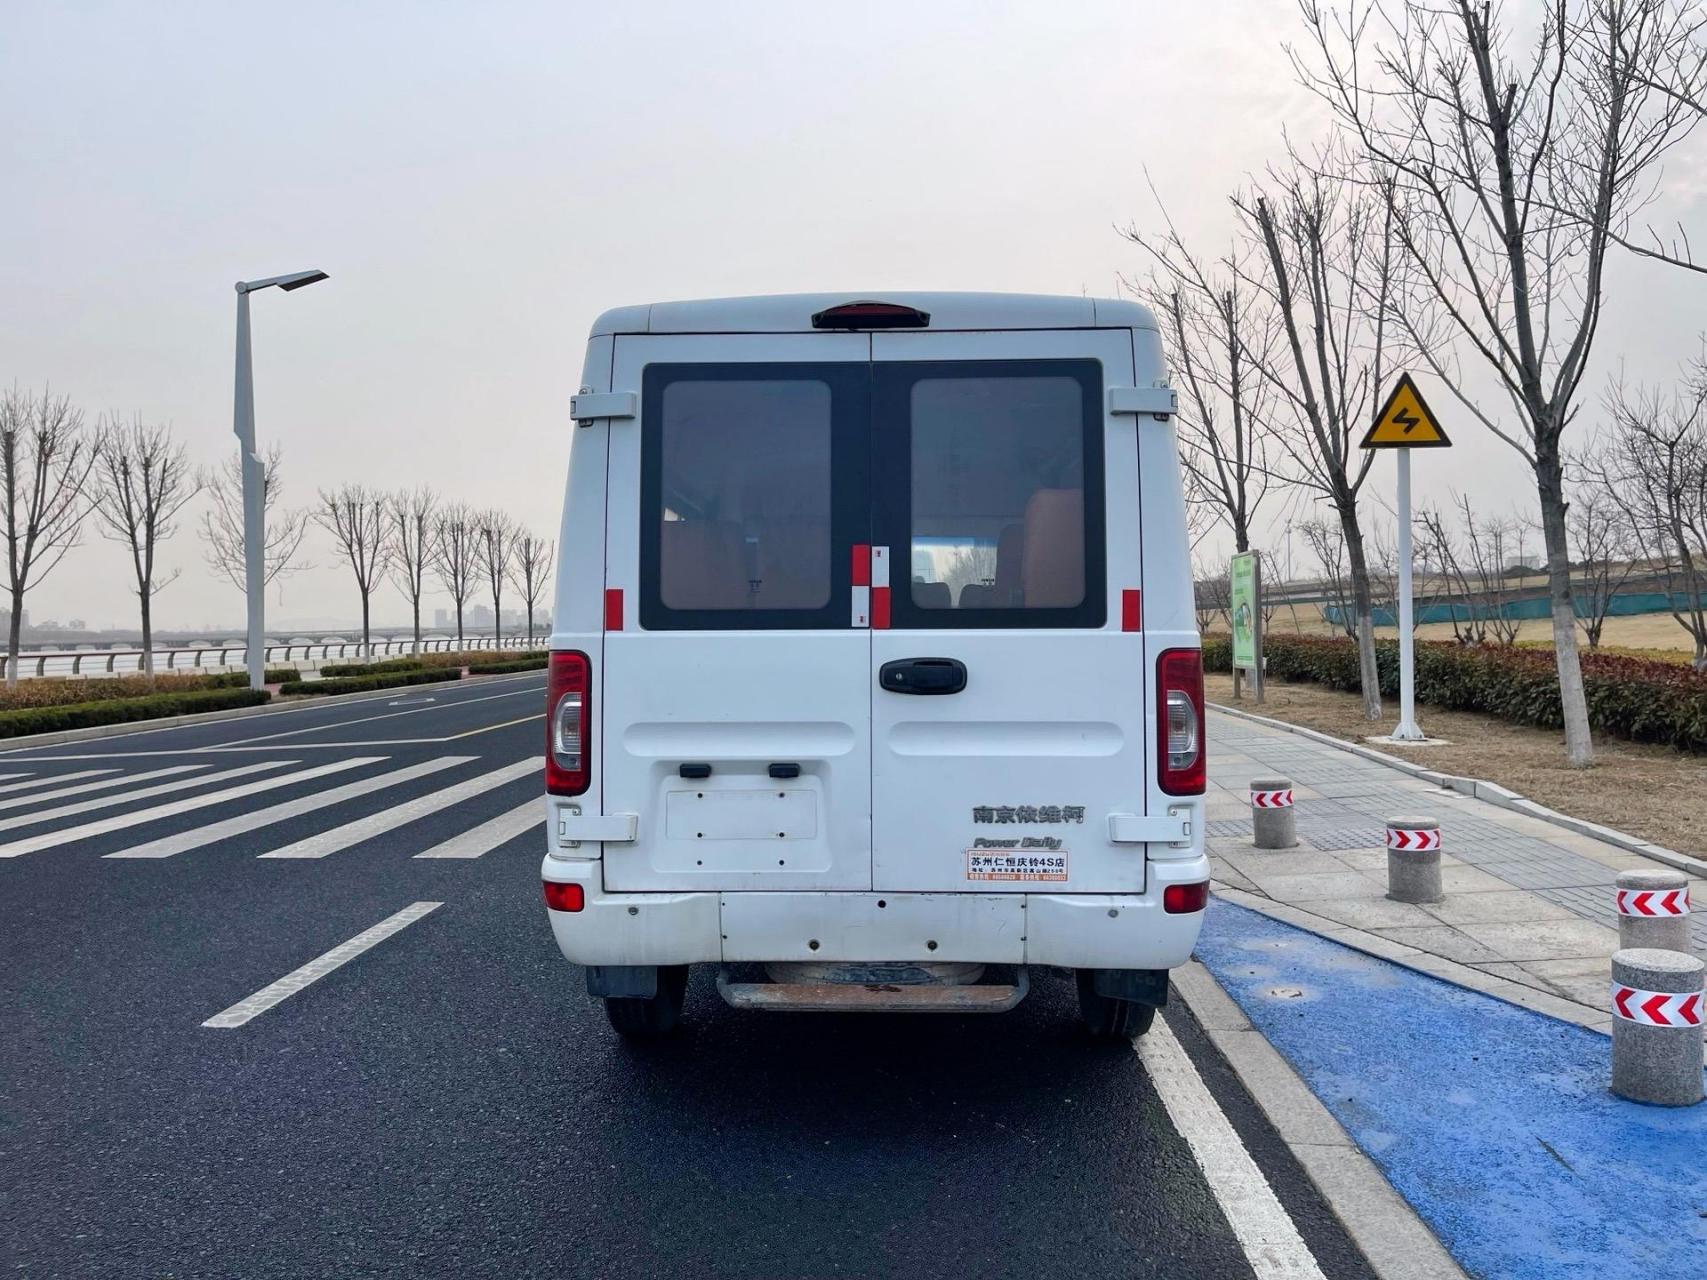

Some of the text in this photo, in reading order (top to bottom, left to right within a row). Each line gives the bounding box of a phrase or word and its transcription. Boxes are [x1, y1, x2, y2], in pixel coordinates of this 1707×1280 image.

[973, 805, 1086, 824] 南京依维柯
[973, 836, 1063, 850] Power Daily
[971, 857, 1065, 867] 苏州仁恒庆铃4S店
